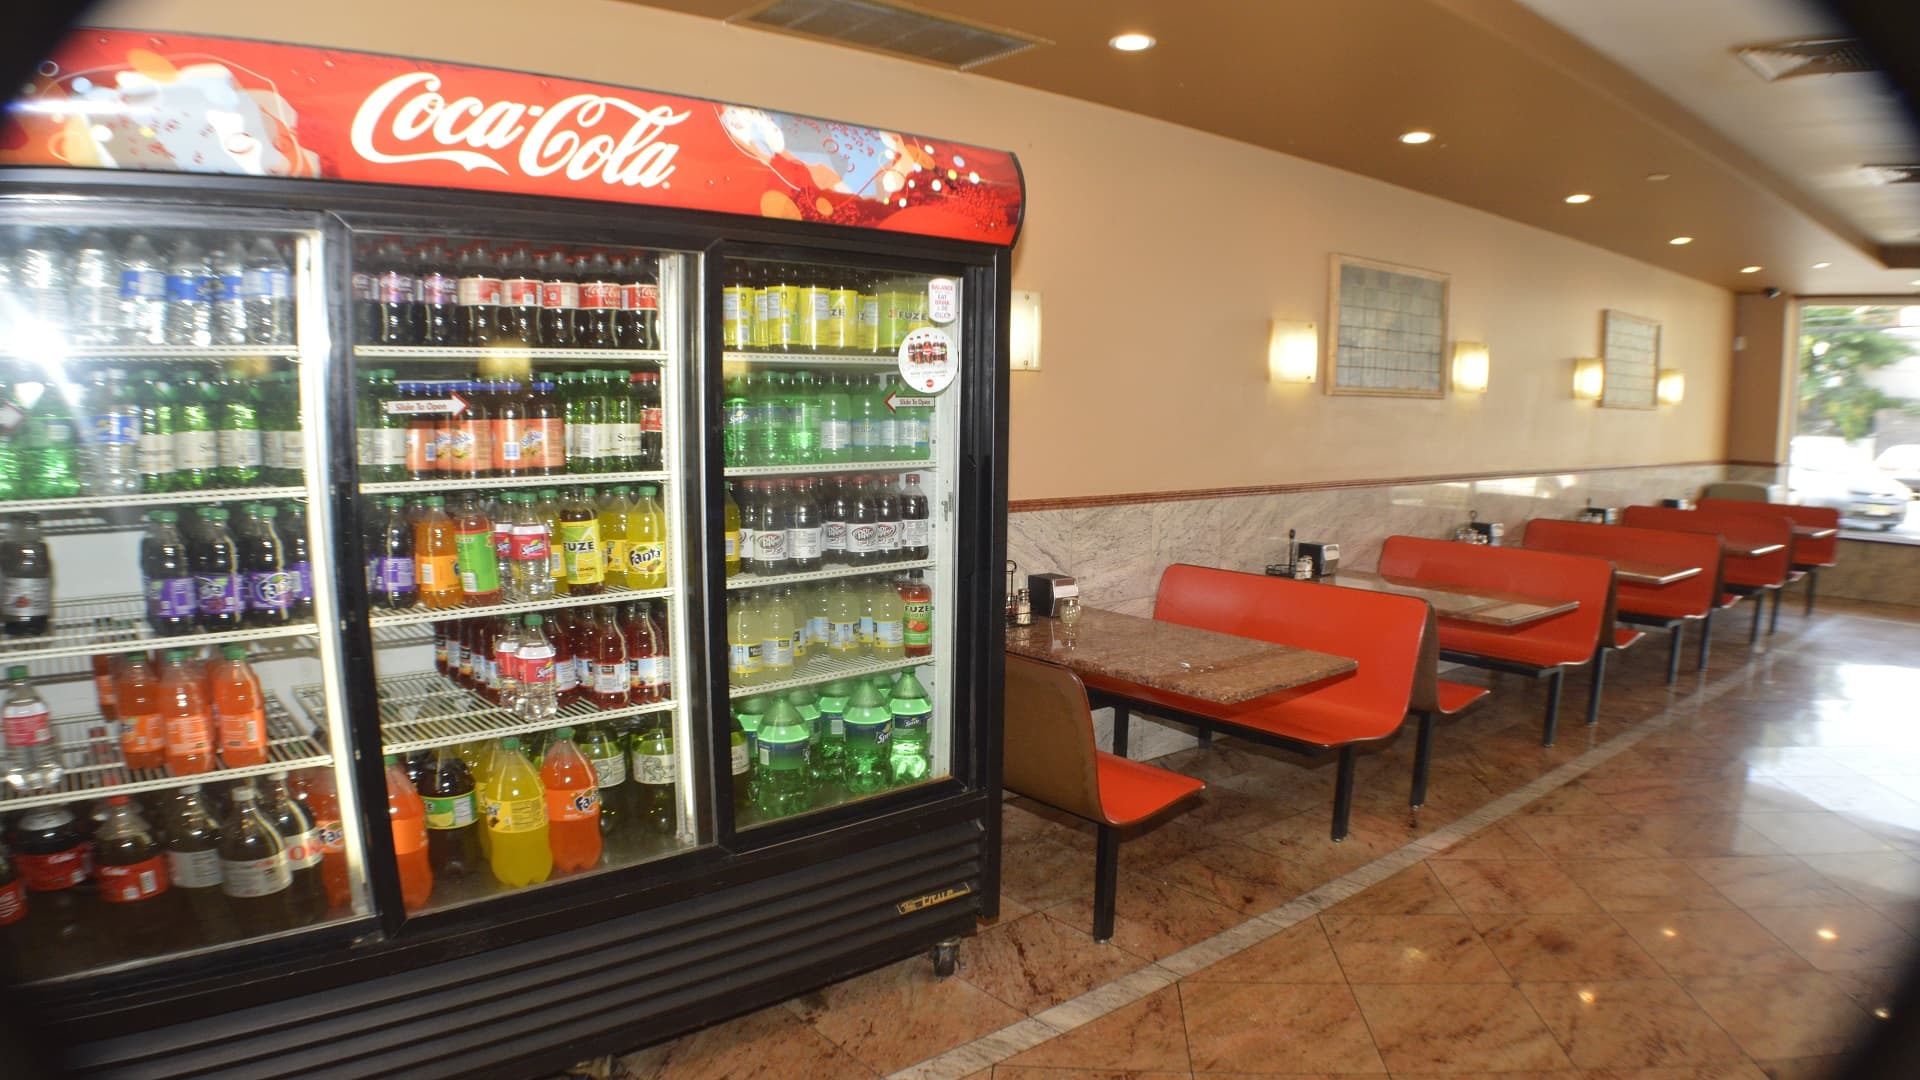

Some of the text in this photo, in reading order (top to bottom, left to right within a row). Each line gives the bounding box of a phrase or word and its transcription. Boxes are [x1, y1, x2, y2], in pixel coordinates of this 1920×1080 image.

[351, 72, 692, 187] Coca-Cola
[899, 312, 926, 320] FUZE
[416, 402, 425, 410] To
[427, 401, 448, 411] Open
[905, 605, 929, 614] FUZE
